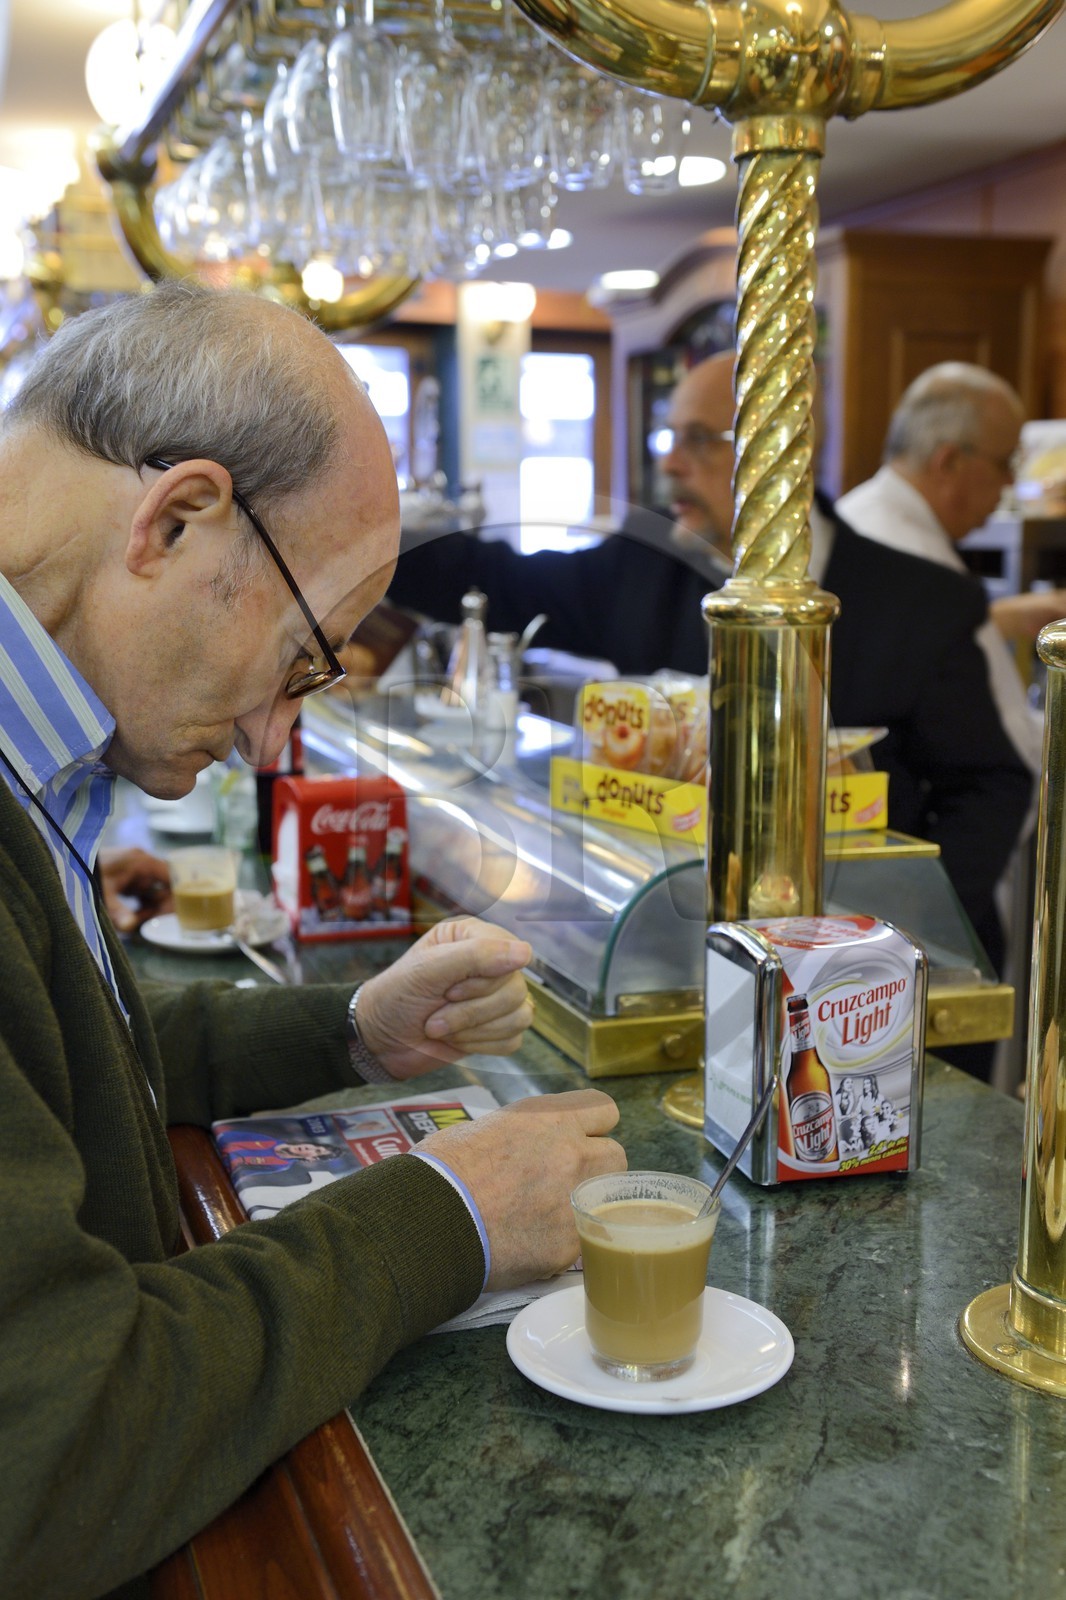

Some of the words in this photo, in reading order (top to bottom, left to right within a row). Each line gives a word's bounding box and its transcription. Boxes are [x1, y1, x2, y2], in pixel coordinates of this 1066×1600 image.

[584, 695, 643, 729] donuts
[596, 773, 665, 814] donuts
[818, 978, 907, 1022] Cruzcampo
[842, 1002, 892, 1047] Light
